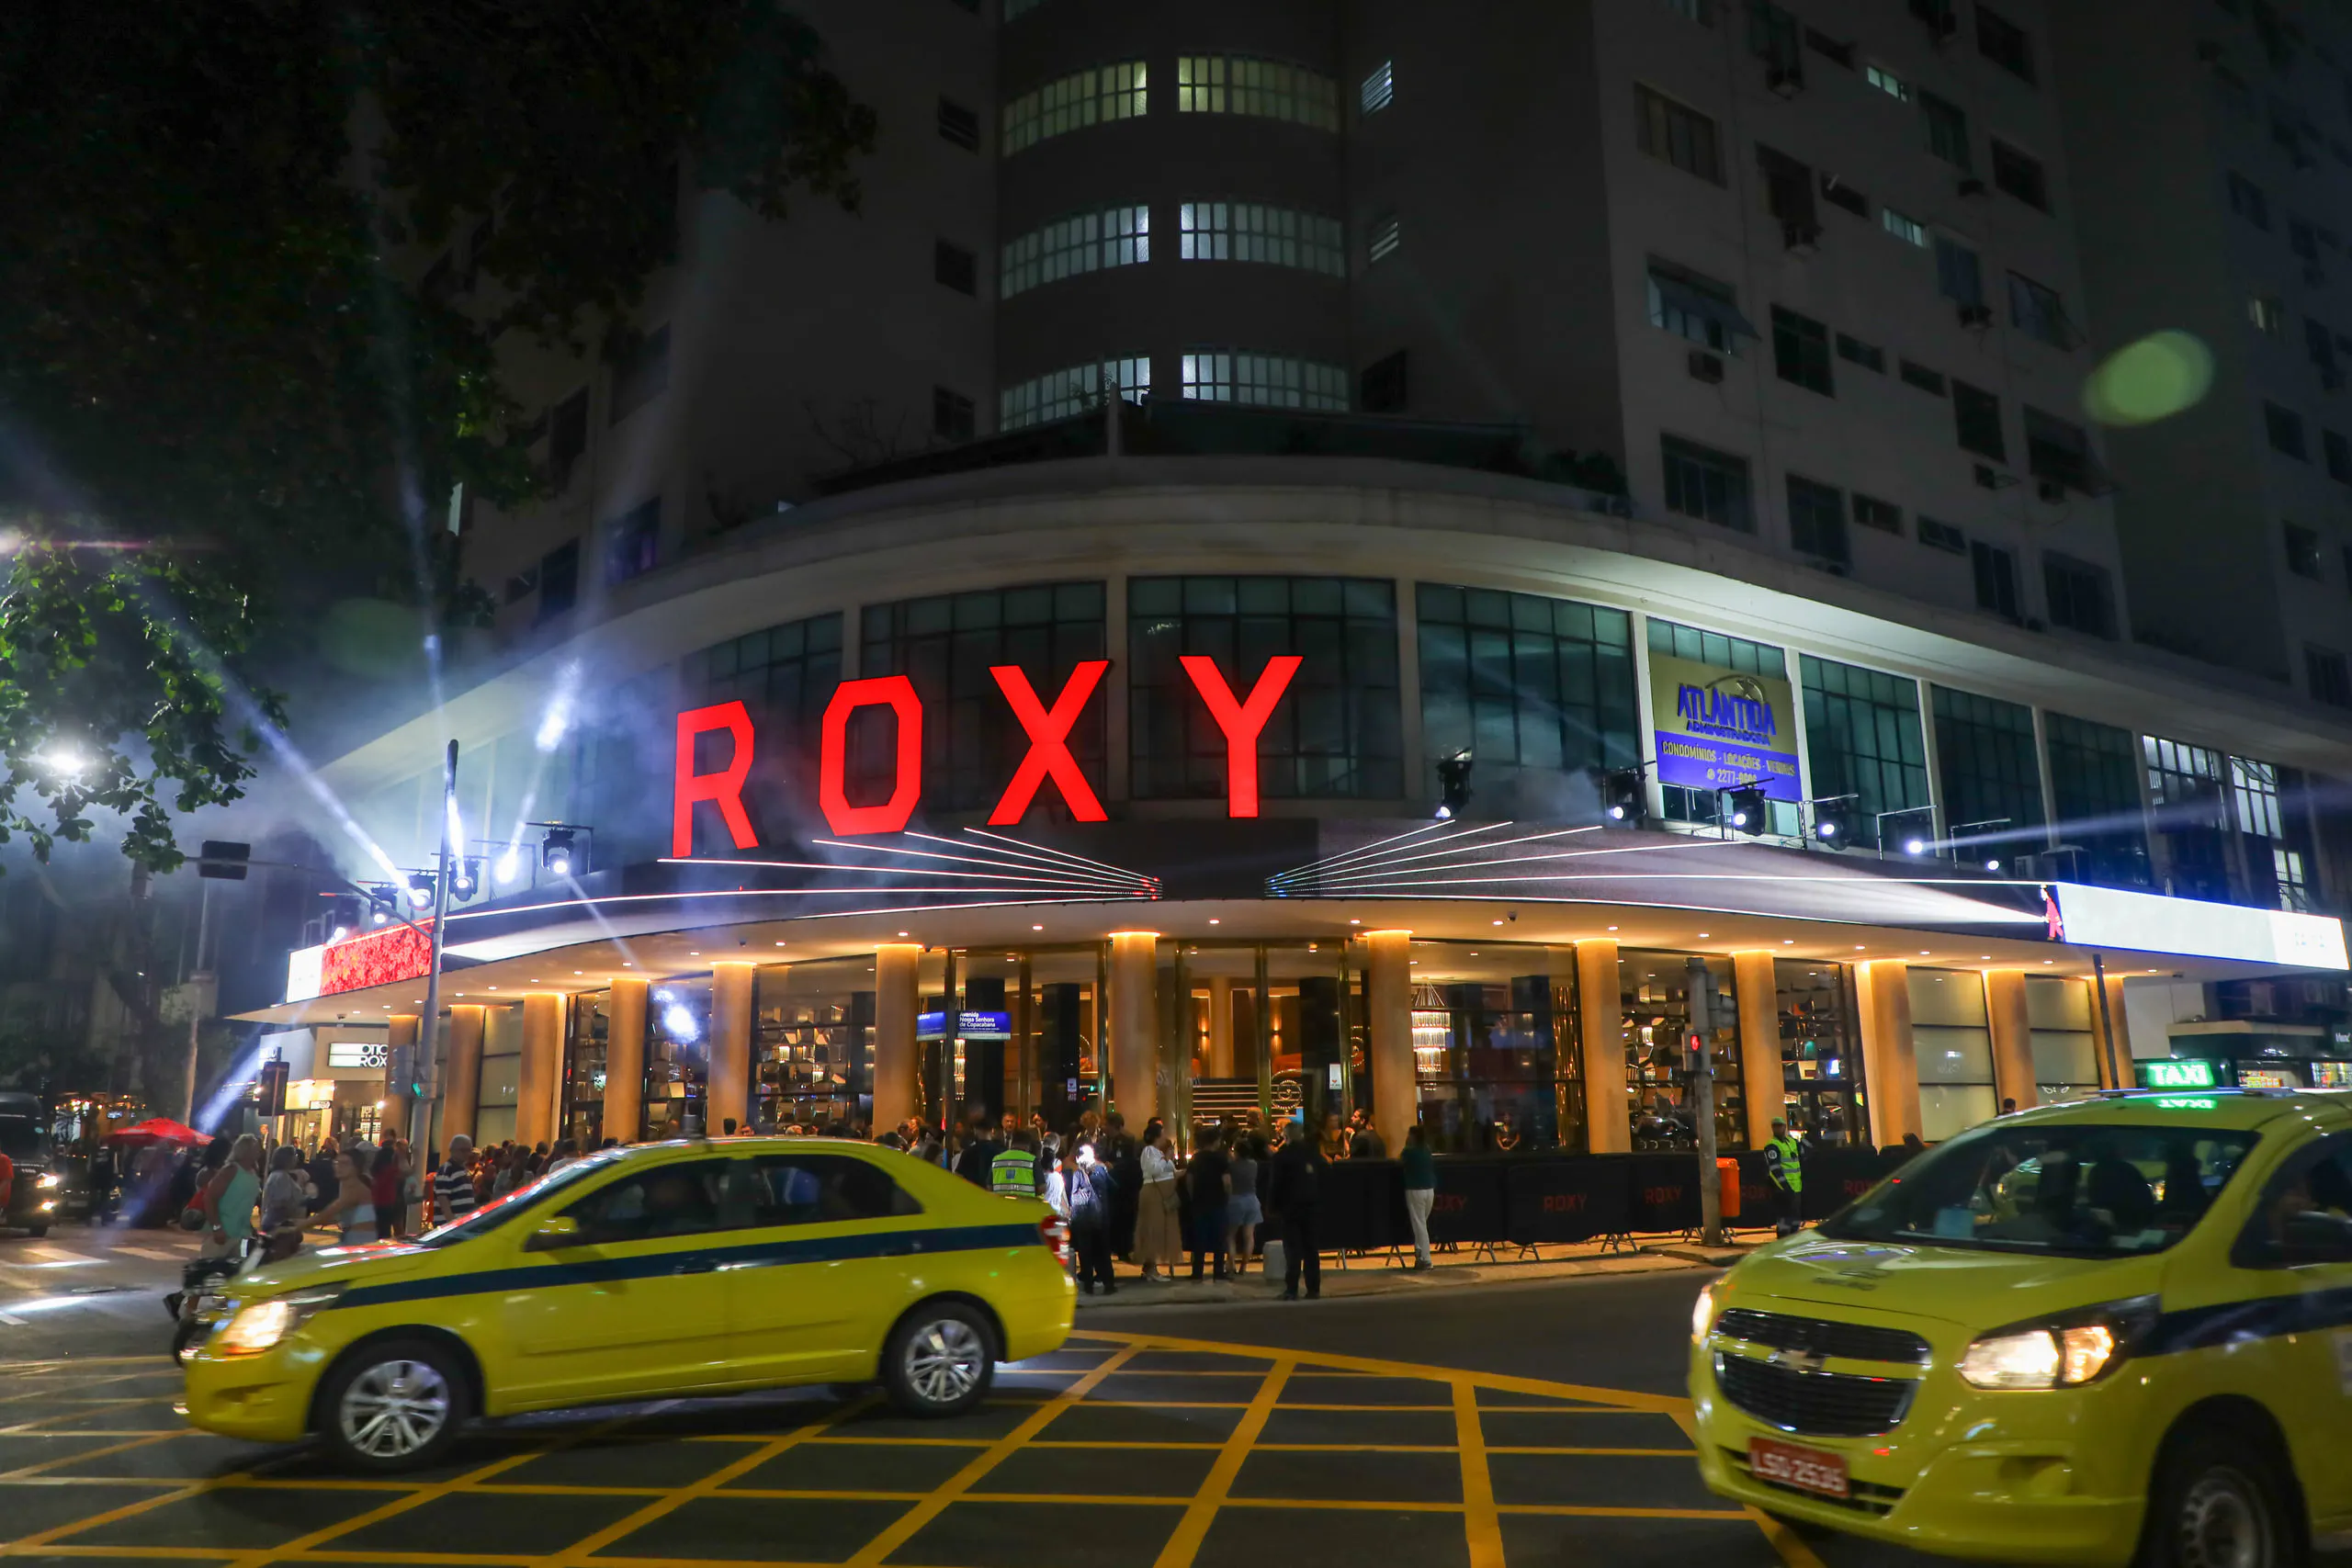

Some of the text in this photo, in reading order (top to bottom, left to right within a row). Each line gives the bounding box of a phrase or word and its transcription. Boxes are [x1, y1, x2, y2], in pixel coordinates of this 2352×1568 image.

[672, 655, 1304, 859] ROXY
[1662, 740, 1717, 762] CONDOMÍNIOS
[361, 1043, 389, 1055] OTIC
[359, 1055, 387, 1067] ROX
[2149, 1065, 2209, 1085] TAXI
[1433, 1193, 1467, 1212] OXY
[1544, 1193, 1587, 1212] ROXY
[1645, 1185, 1681, 1204] ROXY
